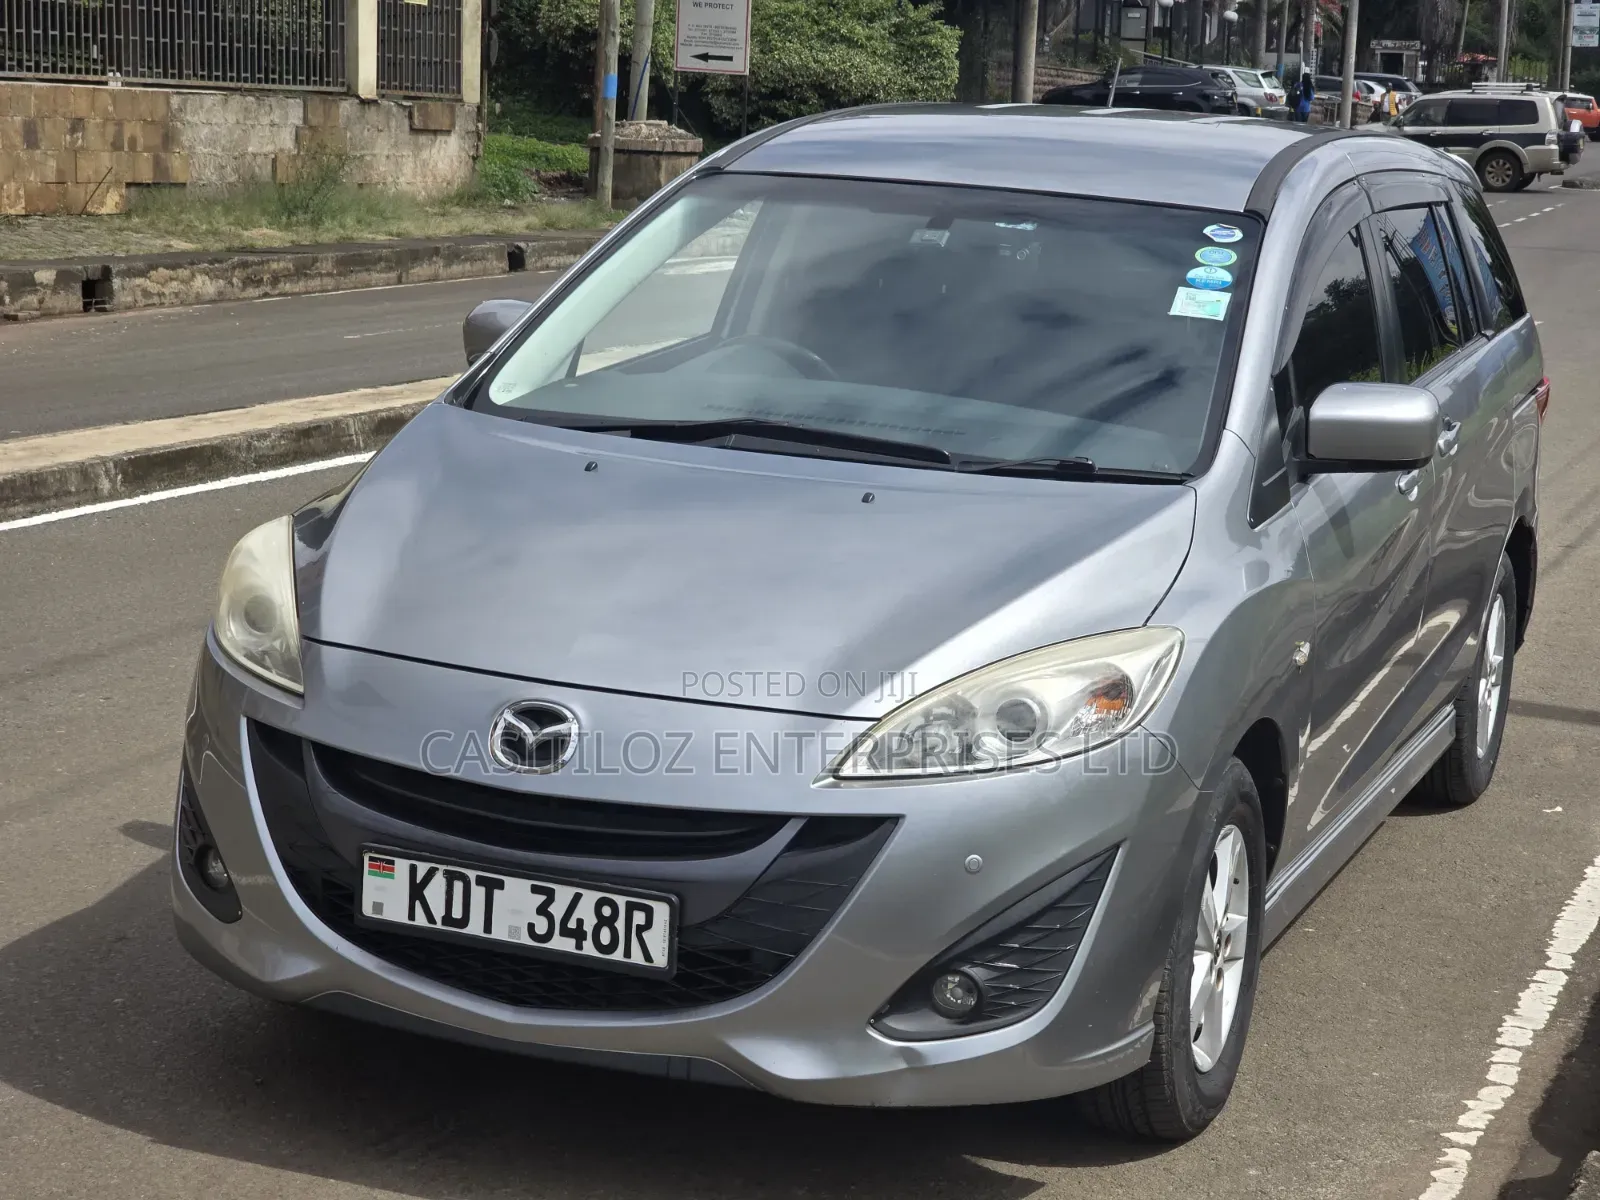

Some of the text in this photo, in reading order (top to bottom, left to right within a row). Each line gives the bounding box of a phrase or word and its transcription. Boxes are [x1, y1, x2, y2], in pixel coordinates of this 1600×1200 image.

[692, 1, 735, 10] WE PROTECT
[407, 863, 505, 935] KDT
[526, 883, 654, 963] 348R
